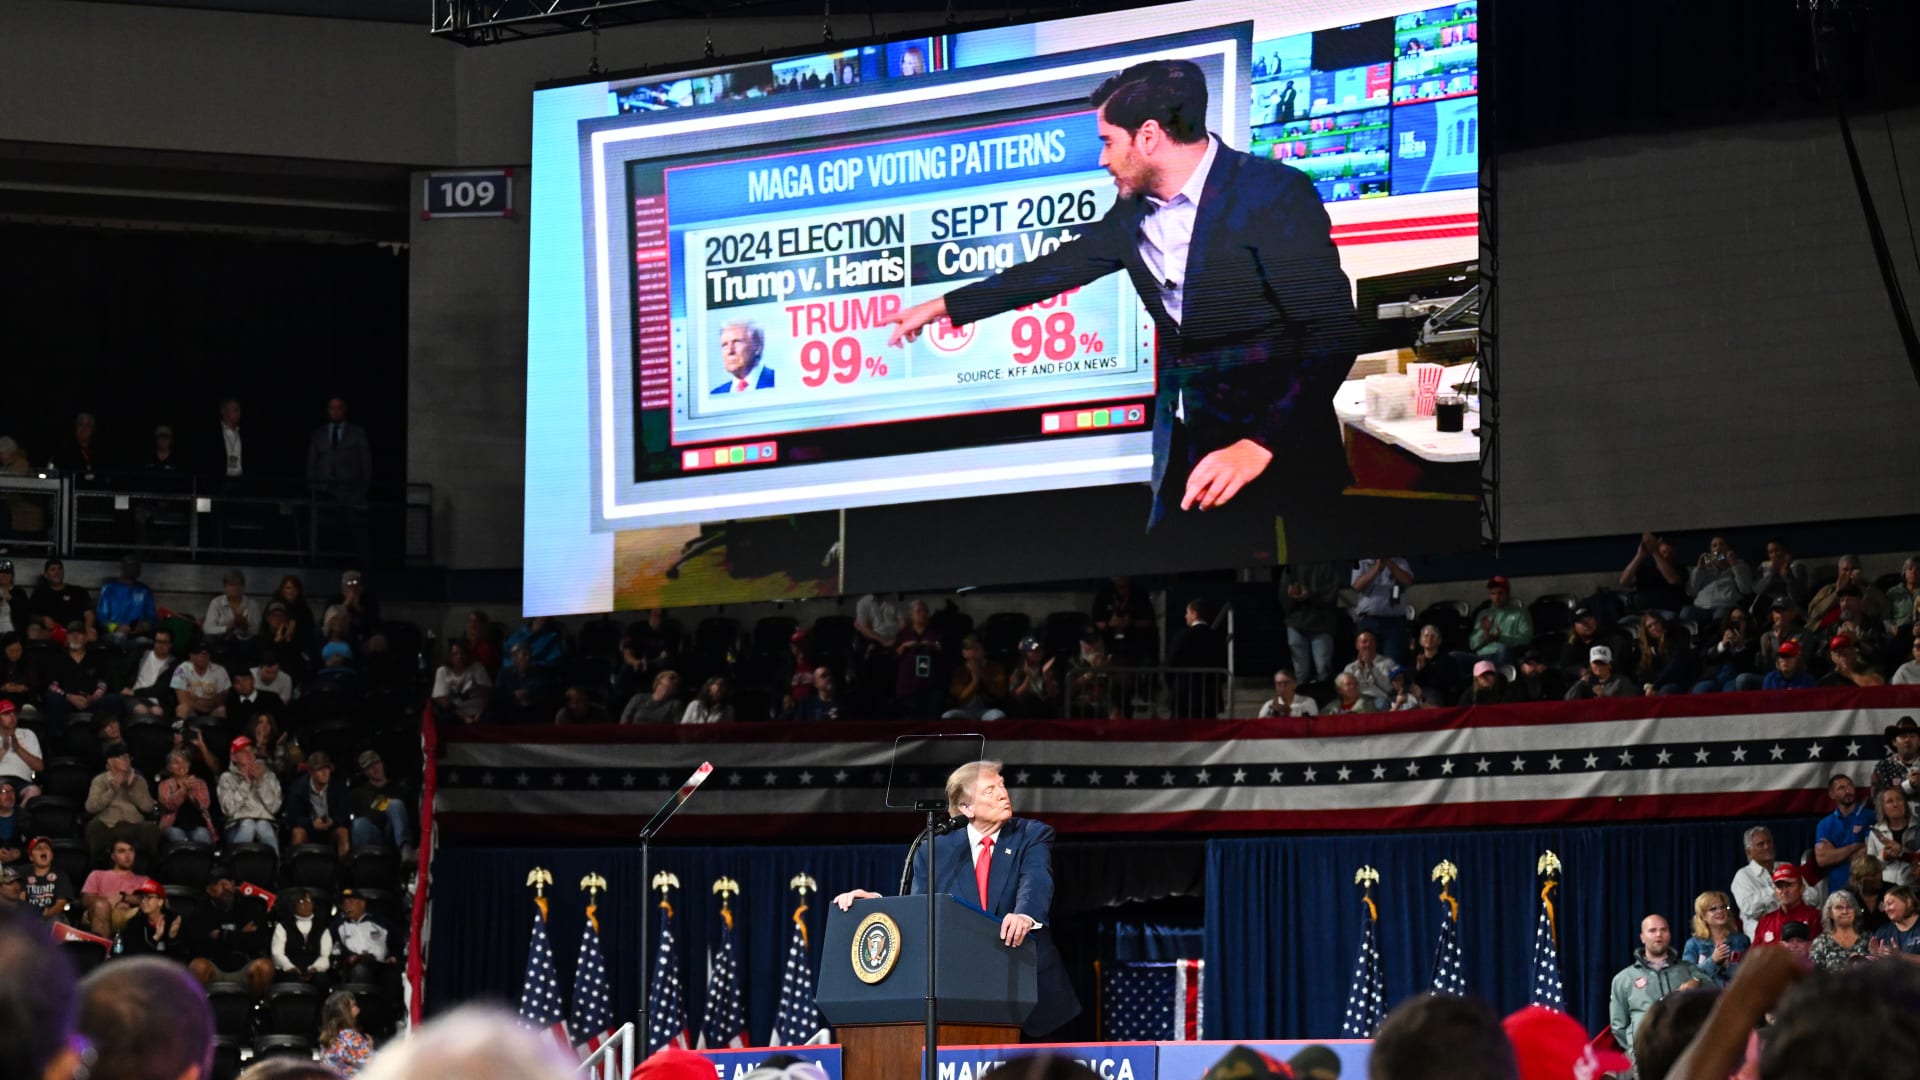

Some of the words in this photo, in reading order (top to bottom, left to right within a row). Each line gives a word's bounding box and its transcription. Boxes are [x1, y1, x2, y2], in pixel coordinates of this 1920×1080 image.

[748, 163, 815, 203] MAGA
[818, 157, 863, 194] GOP
[867, 145, 946, 188] VOTING
[950, 128, 1066, 177] PATTERNS
[441, 181, 495, 207] 109
[931, 201, 1008, 240] SEPT
[1017, 189, 1096, 230] 2026
[705, 231, 773, 267] 2024
[778, 213, 905, 257] ELECTION
[938, 241, 1014, 275] Cong
[707, 269, 796, 303] Trump
[798, 266, 822, 292] v.
[825, 250, 905, 289] Harris
[785, 294, 902, 338] TRUMP
[1011, 311, 1104, 364] 98%
[800, 336, 888, 388] 99%
[1008, 365, 1028, 377] KFF
[1032, 363, 1055, 375] AND
[1058, 360, 1080, 372] FOX
[1084, 357, 1117, 370] NEWS
[938, 1060, 1006, 1080] MAK
